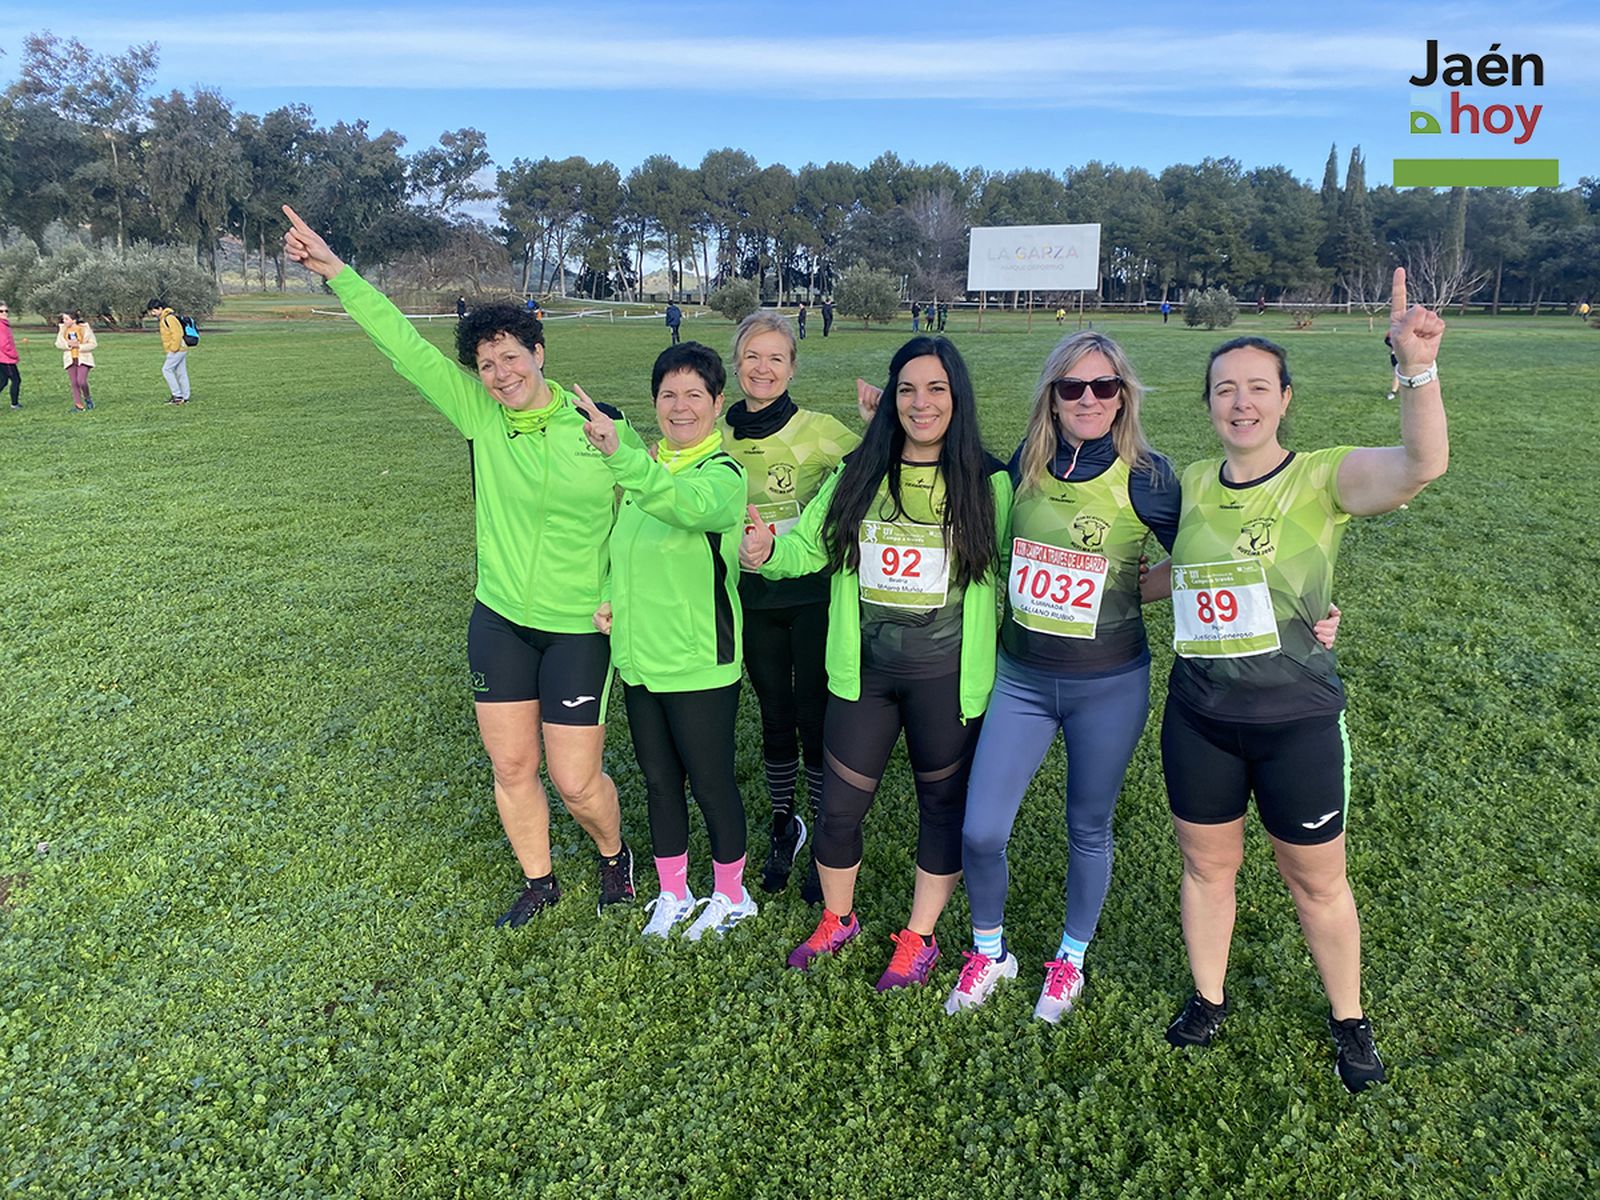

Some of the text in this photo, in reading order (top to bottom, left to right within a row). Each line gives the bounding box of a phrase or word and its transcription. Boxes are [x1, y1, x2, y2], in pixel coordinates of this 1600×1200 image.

[988, 244, 1079, 261] LA GARZA
[881, 547, 922, 577] 92
[1068, 553, 1076, 568] DE
[1076, 555, 1084, 569] LA
[1085, 556, 1104, 573] GARZA
[1017, 565, 1096, 609] 1032
[1196, 590, 1238, 624] 89
